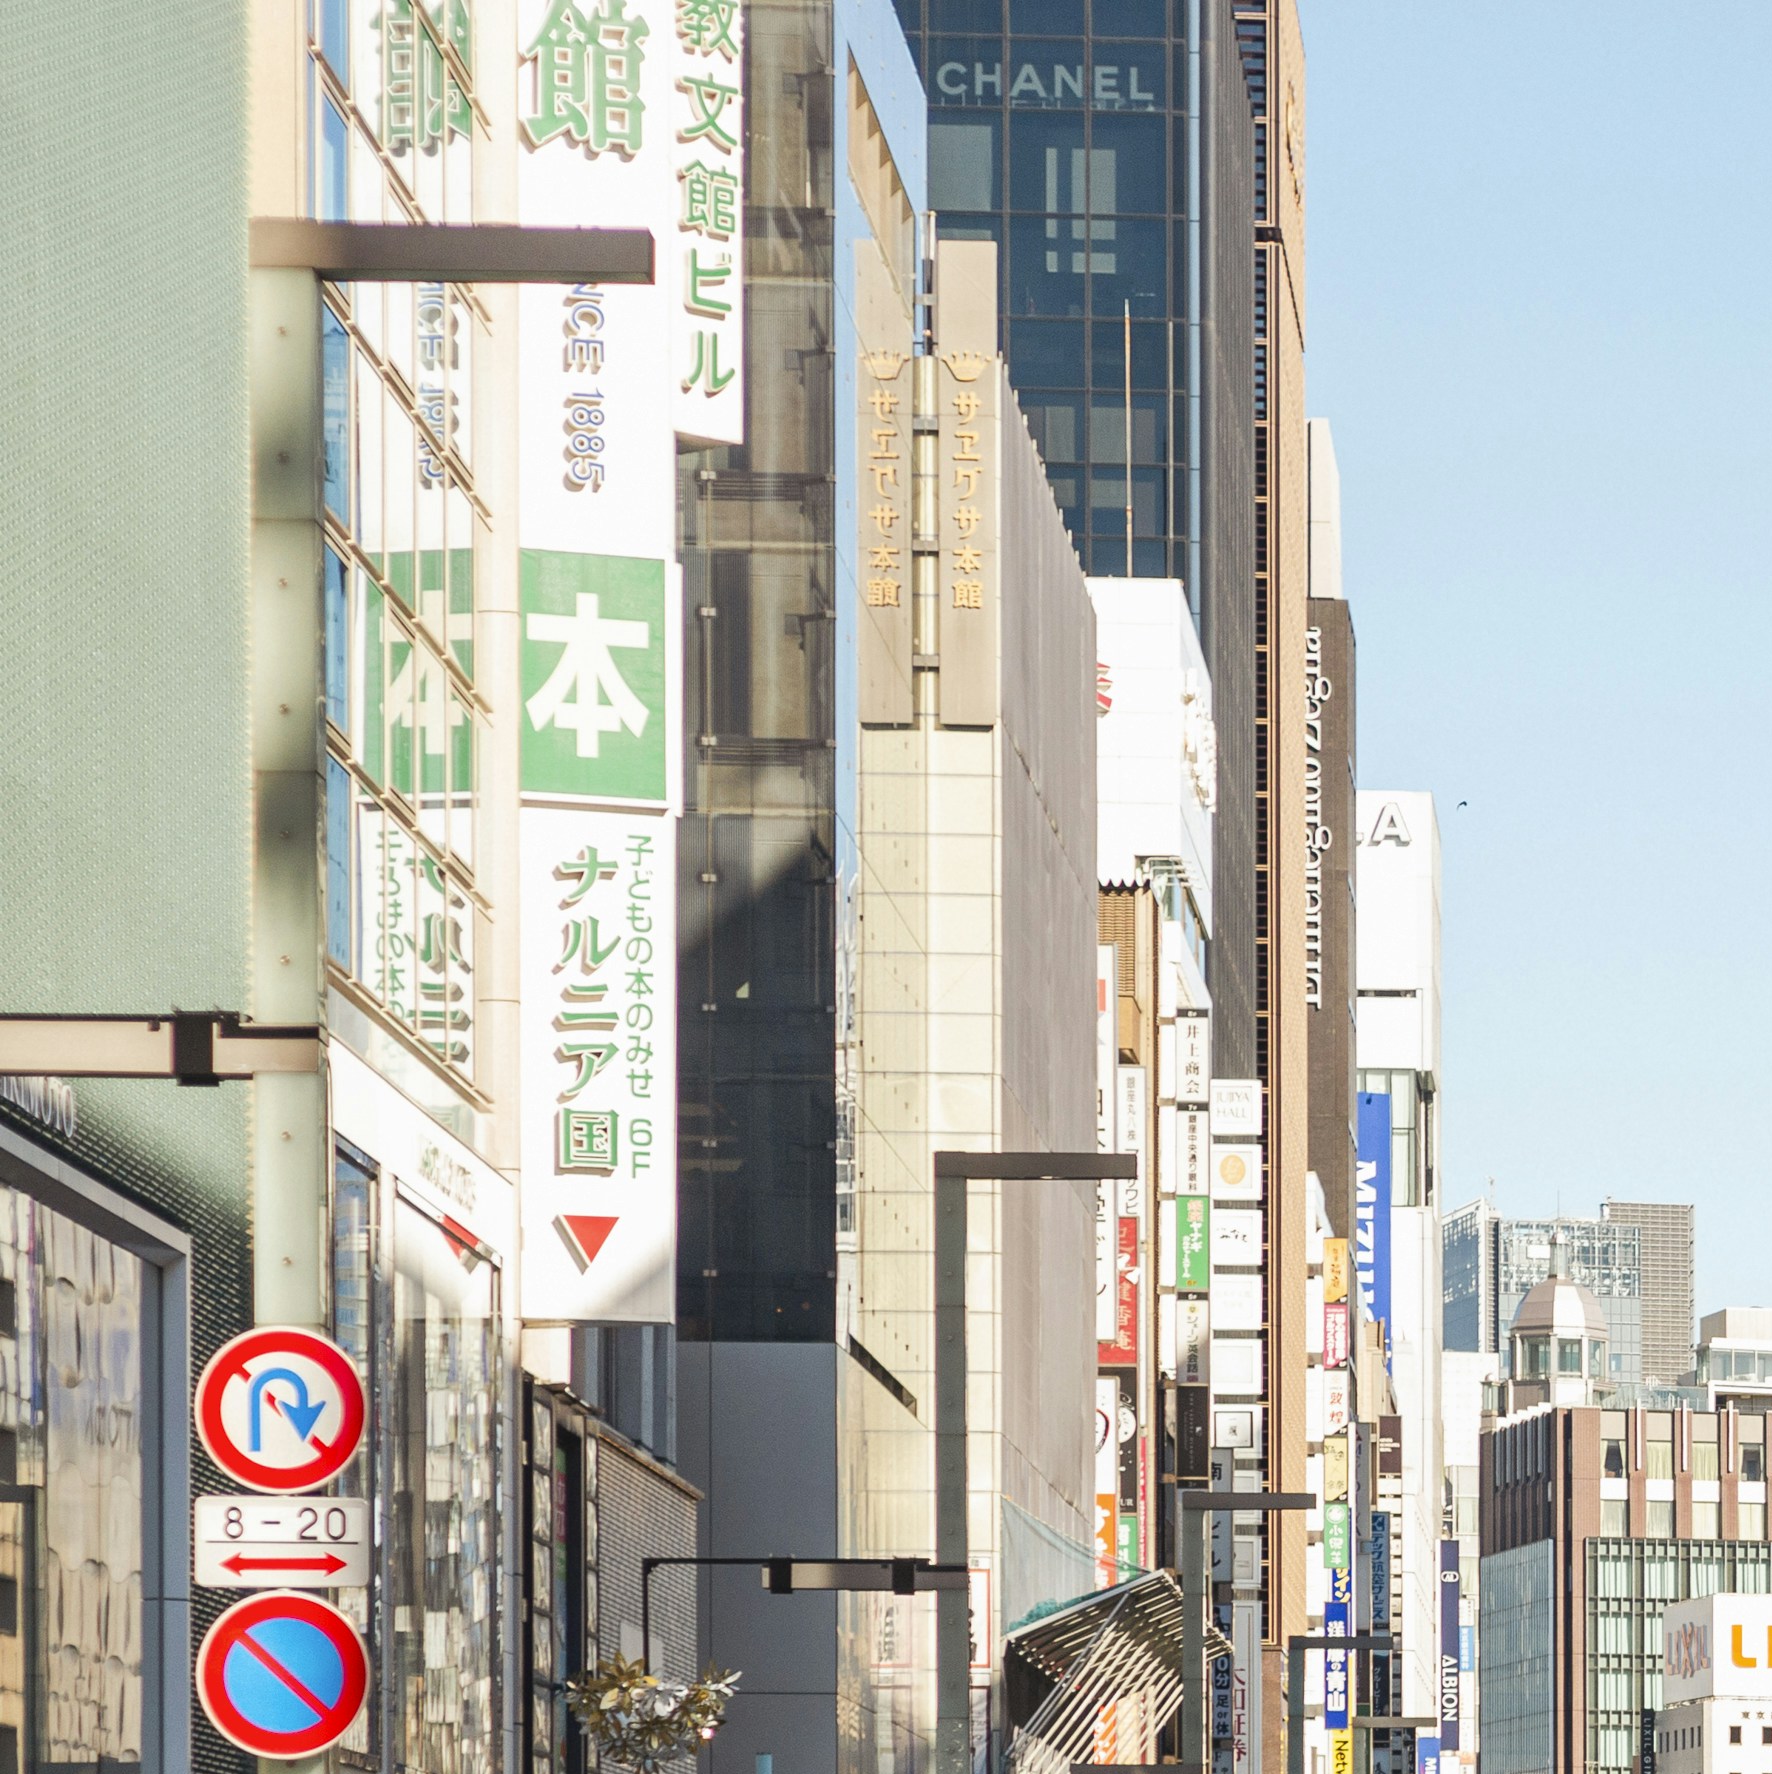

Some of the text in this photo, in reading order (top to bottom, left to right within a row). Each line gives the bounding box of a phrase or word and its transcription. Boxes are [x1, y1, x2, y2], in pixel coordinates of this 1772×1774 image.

[936, 61, 1155, 100] CHANEL
[568, 391, 606, 484] 1885
[527, 592, 649, 757] 本
[556, 846, 622, 1170] ナルニア国
[626, 834, 654, 1178] 子どもの本のみせ 6F
[1185, 1025, 1200, 1094] 井上商会
[1441, 1654, 1459, 1722] ALBION
[1664, 1619, 1711, 1681] LIXIL
